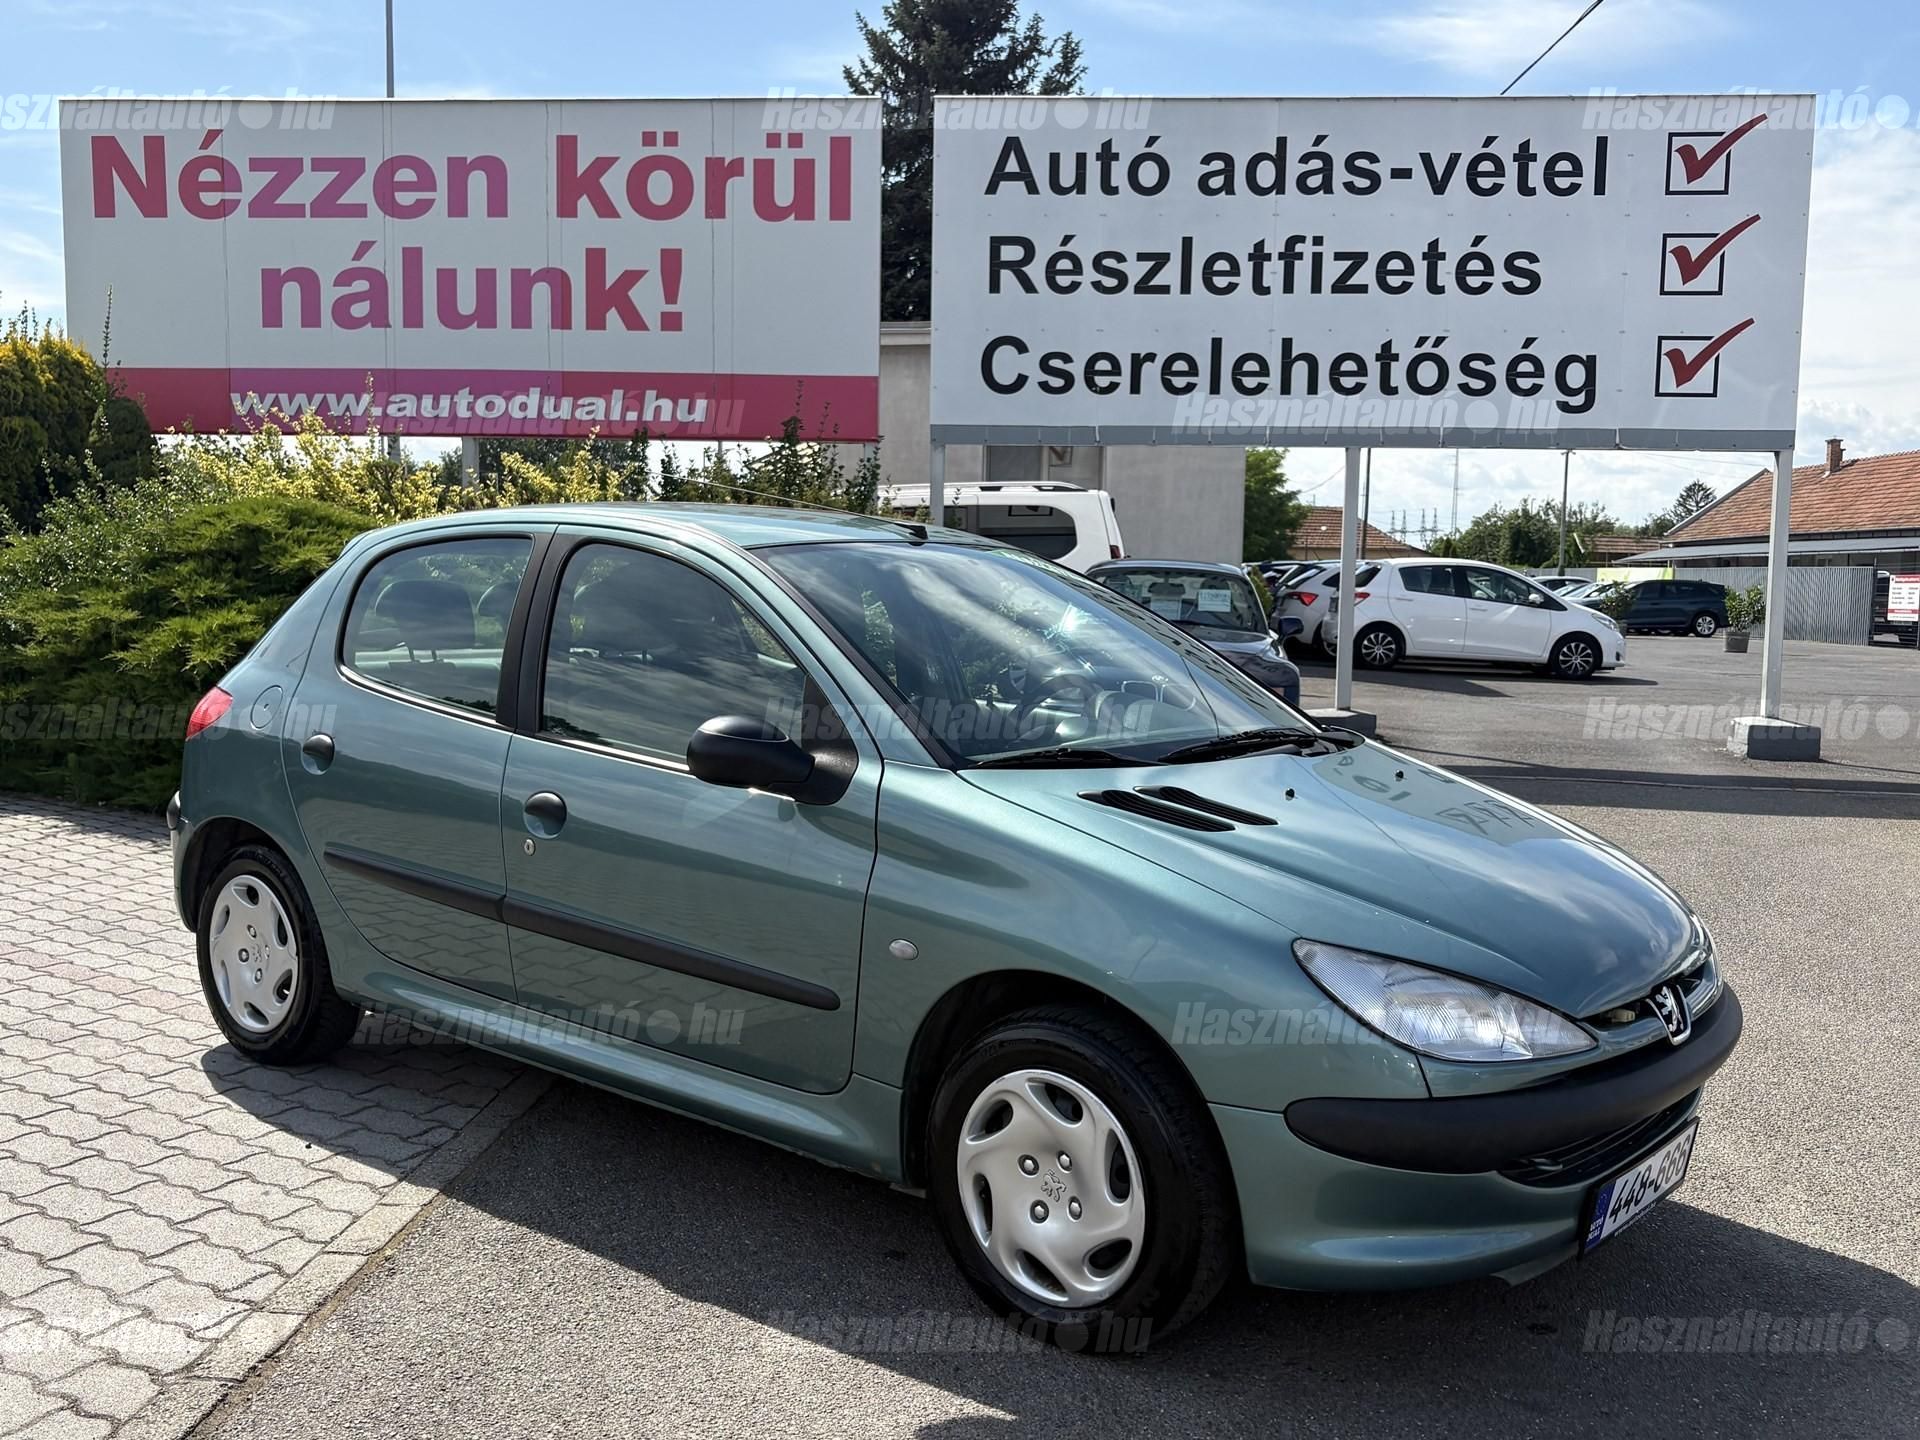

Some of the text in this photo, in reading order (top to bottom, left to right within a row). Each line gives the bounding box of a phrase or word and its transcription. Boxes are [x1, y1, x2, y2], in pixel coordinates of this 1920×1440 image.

[91, 129, 851, 221] Nézzen körül
[985, 134, 1609, 197] Autó adás-vétel
[261, 240, 682, 331] nálunk!
[988, 235, 1542, 296] Részletfizetés
[230, 386, 709, 423] www.autodual.hu
[980, 335, 1597, 415] Cserelehetőség
[1608, 1133, 1691, 1224] 448-666
